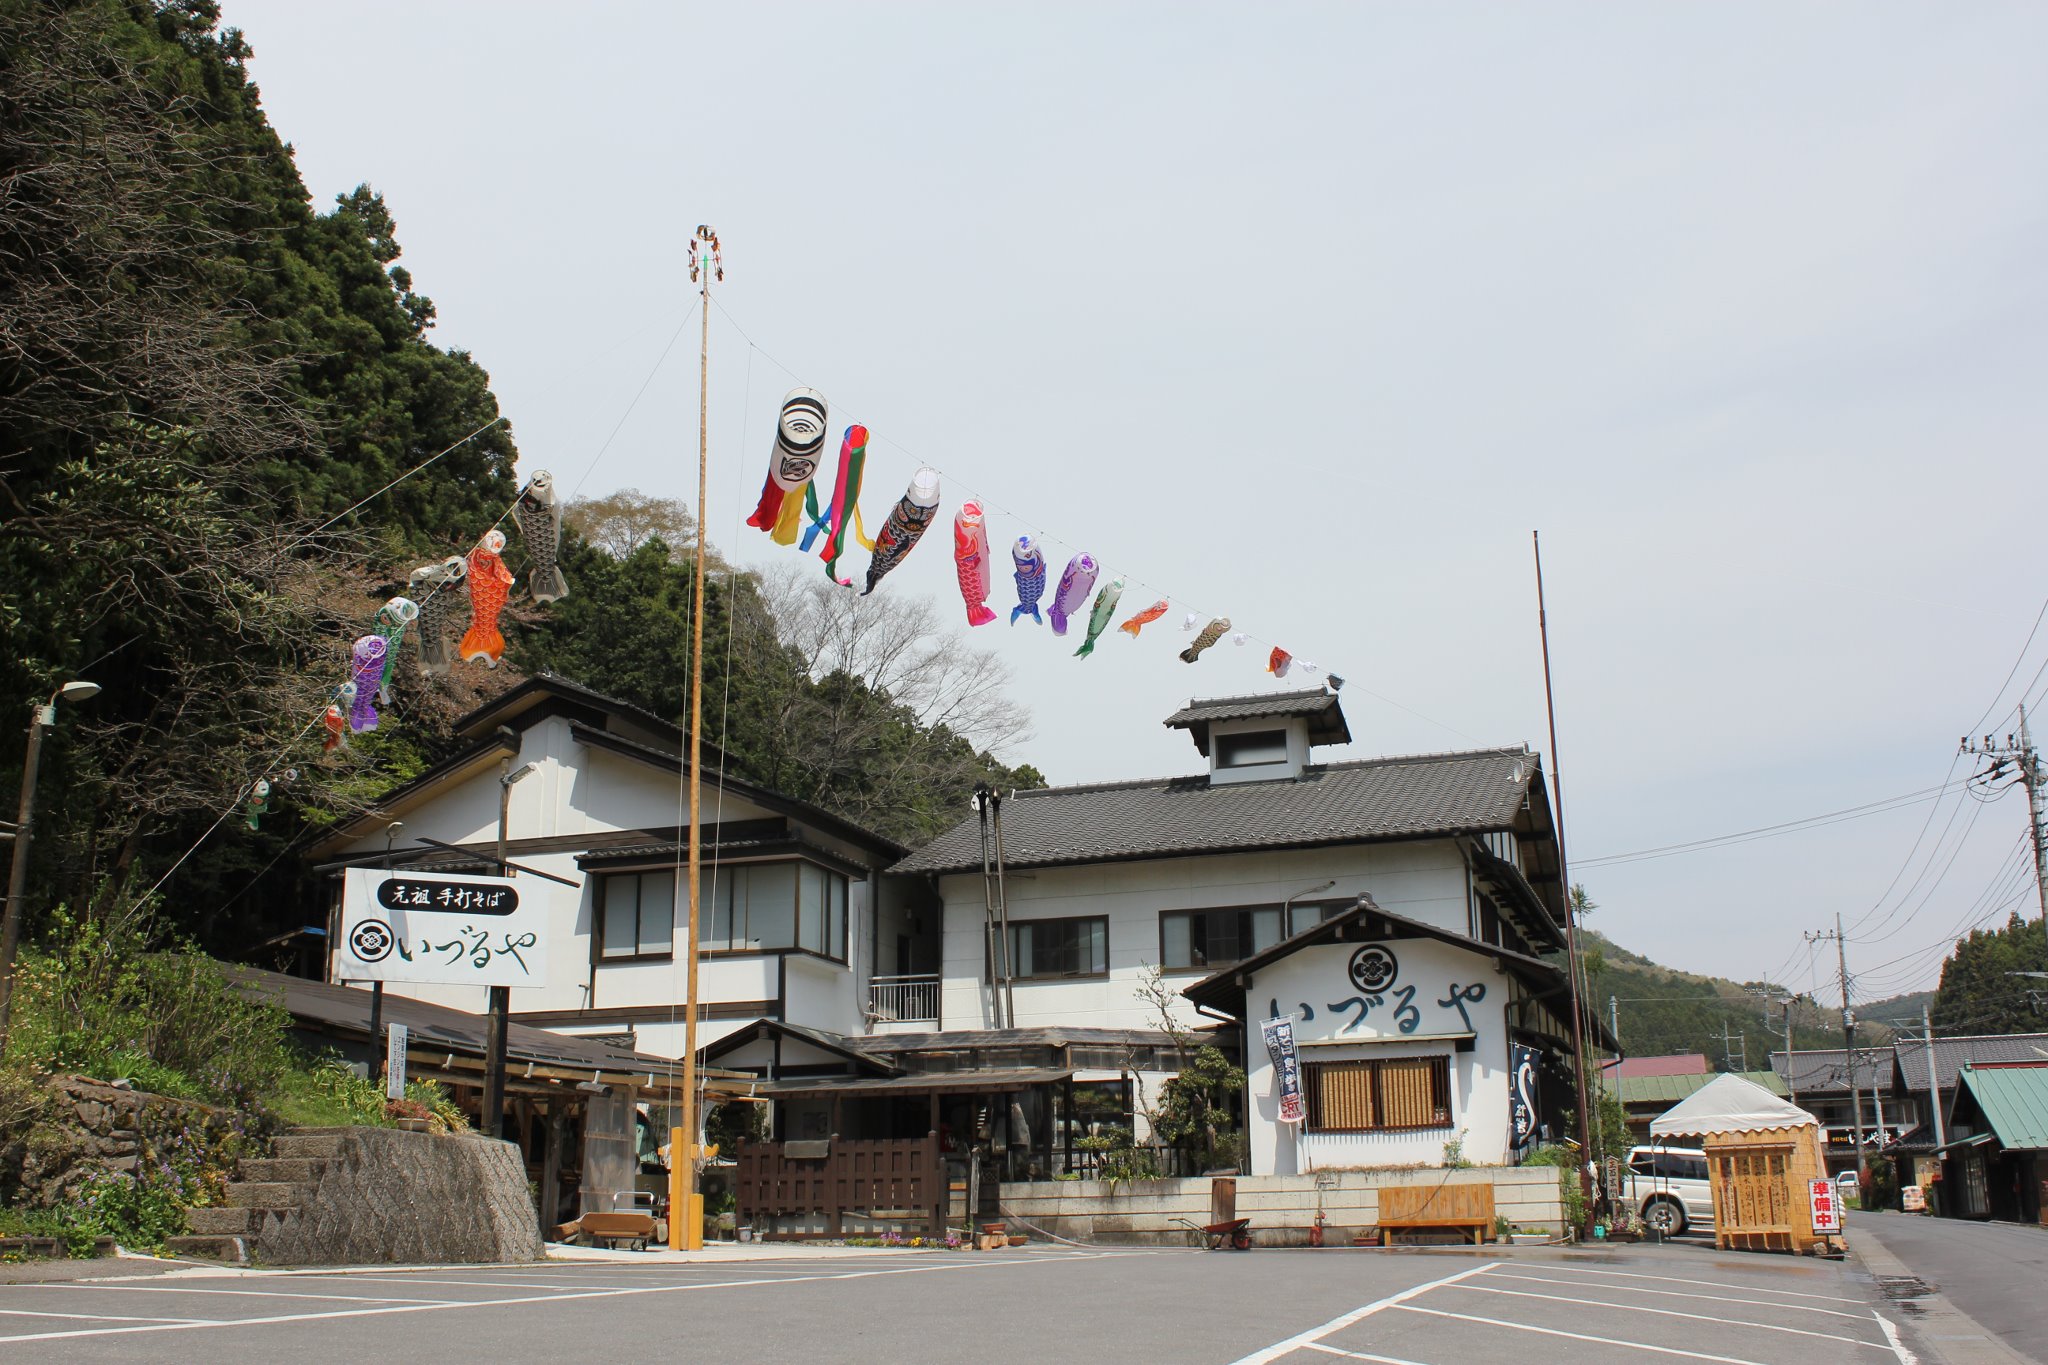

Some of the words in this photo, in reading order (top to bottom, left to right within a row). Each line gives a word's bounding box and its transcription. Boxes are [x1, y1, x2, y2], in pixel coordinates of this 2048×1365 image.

[391, 886, 431, 905] 元祖
[437, 888, 506, 909] 手打そば
[398, 925, 537, 975] いづるや
[1270, 983, 1486, 1033] いづるや
[1281, 1102, 1300, 1114] CRT
[1813, 1181, 1832, 1227] 準備中
